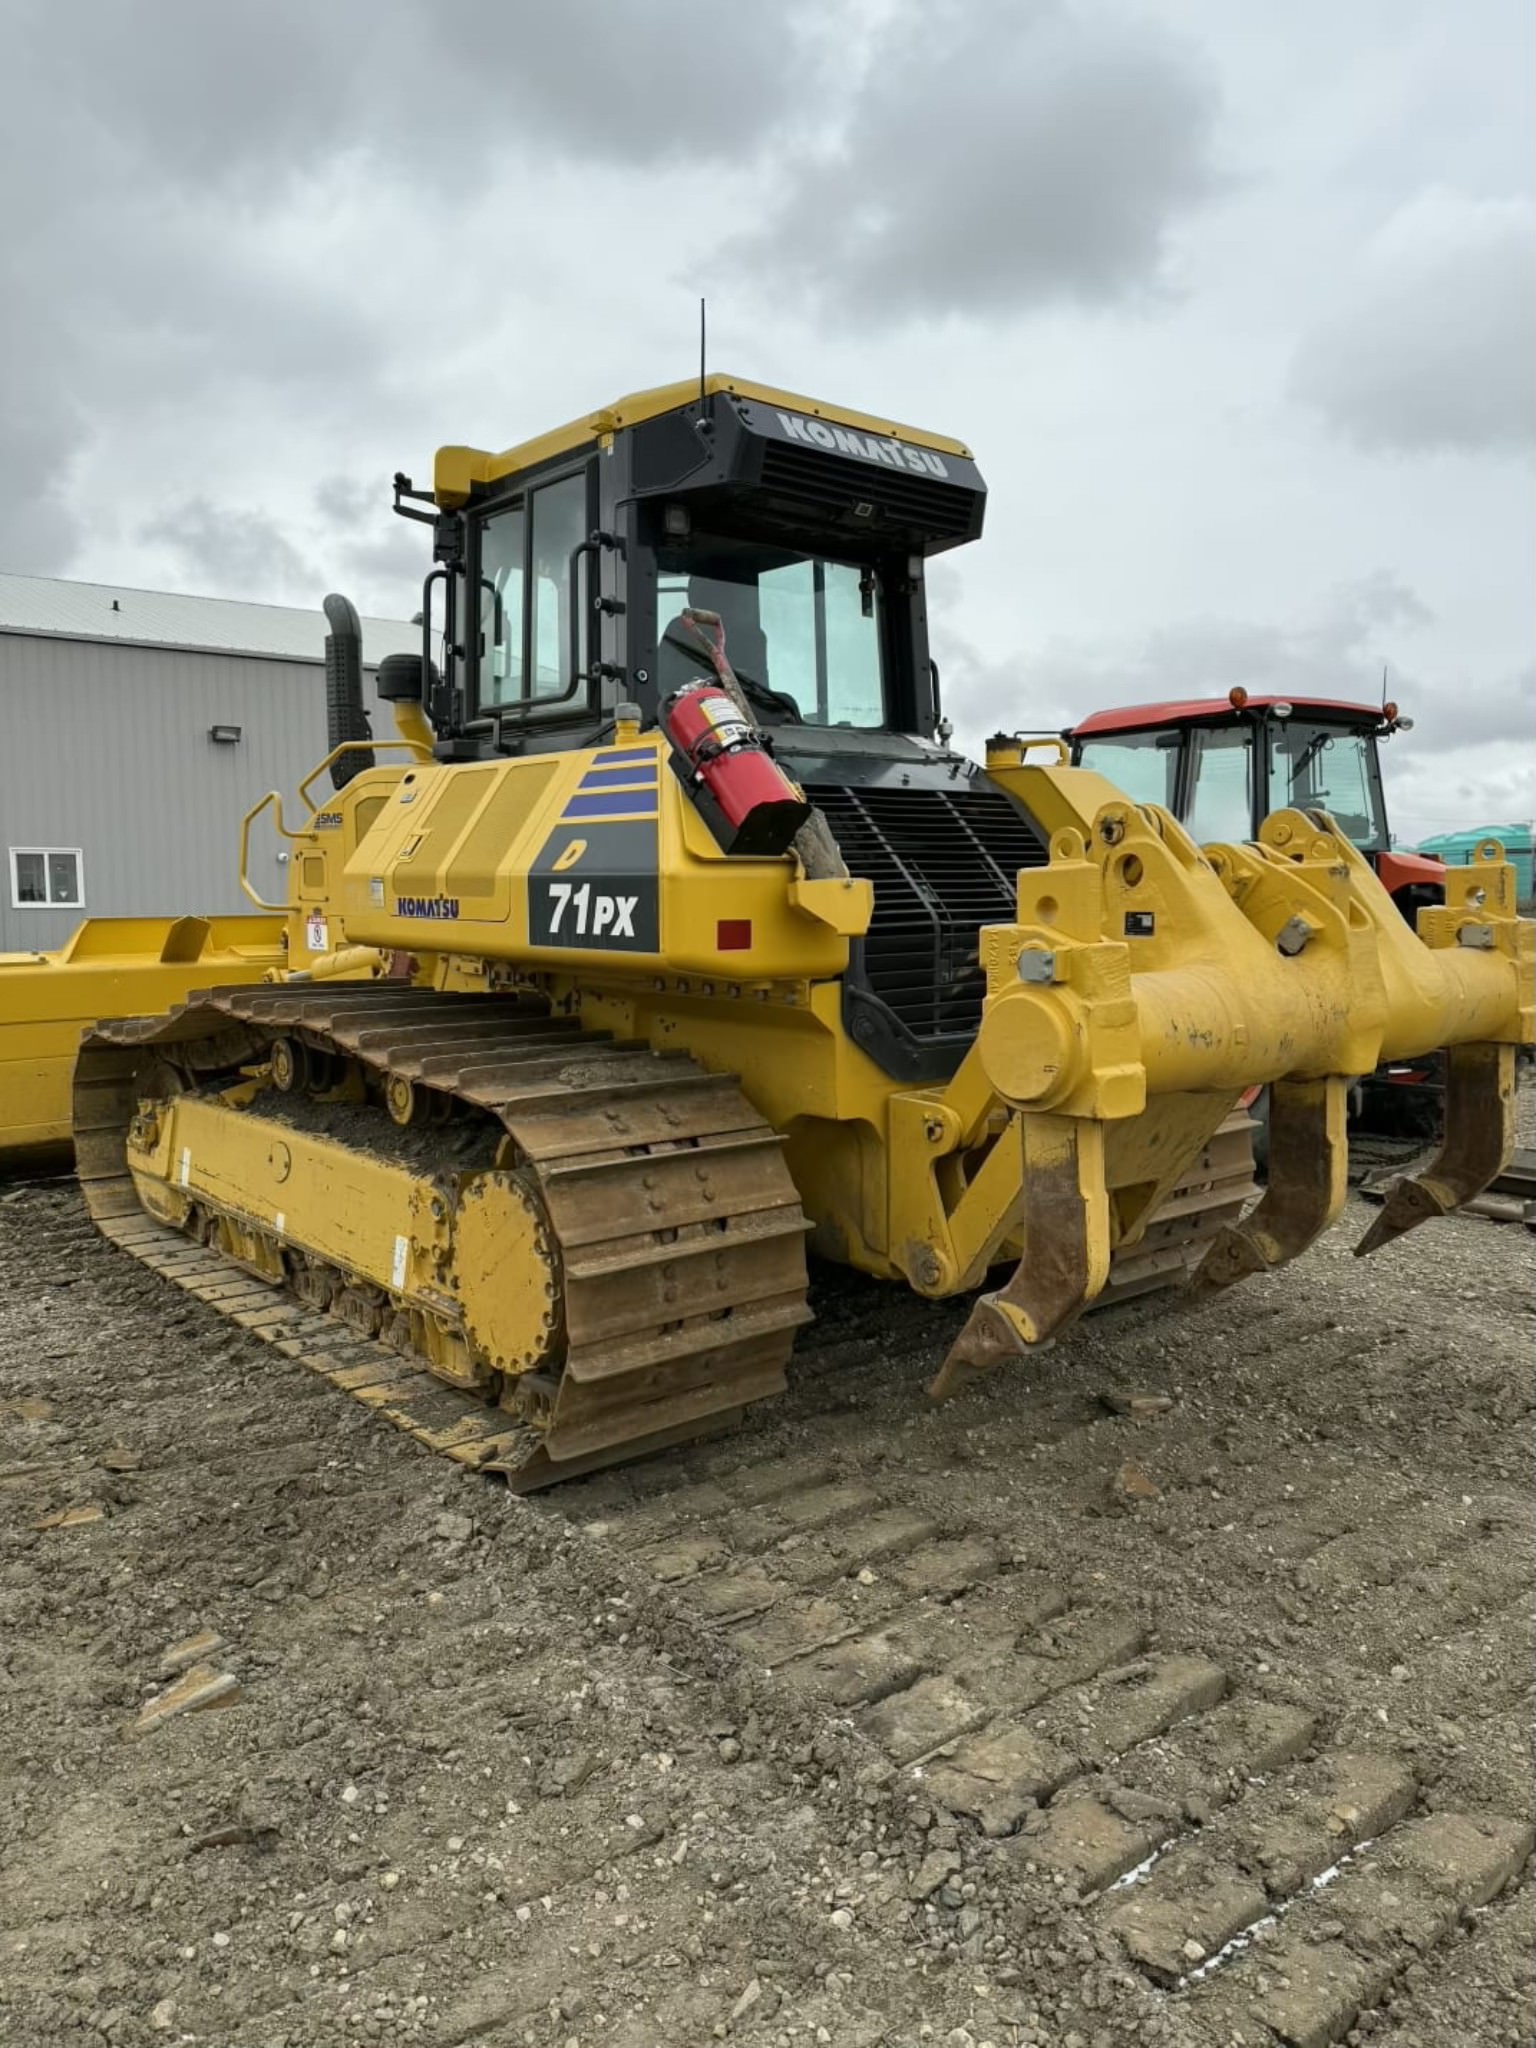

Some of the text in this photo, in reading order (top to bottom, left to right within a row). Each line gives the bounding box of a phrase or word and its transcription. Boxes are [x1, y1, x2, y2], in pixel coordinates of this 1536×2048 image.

[776, 412, 949, 478] KOMATSU
[551, 839, 588, 871] D
[397, 893, 460, 919] KOMATSU
[548, 883, 639, 937] 71PX
